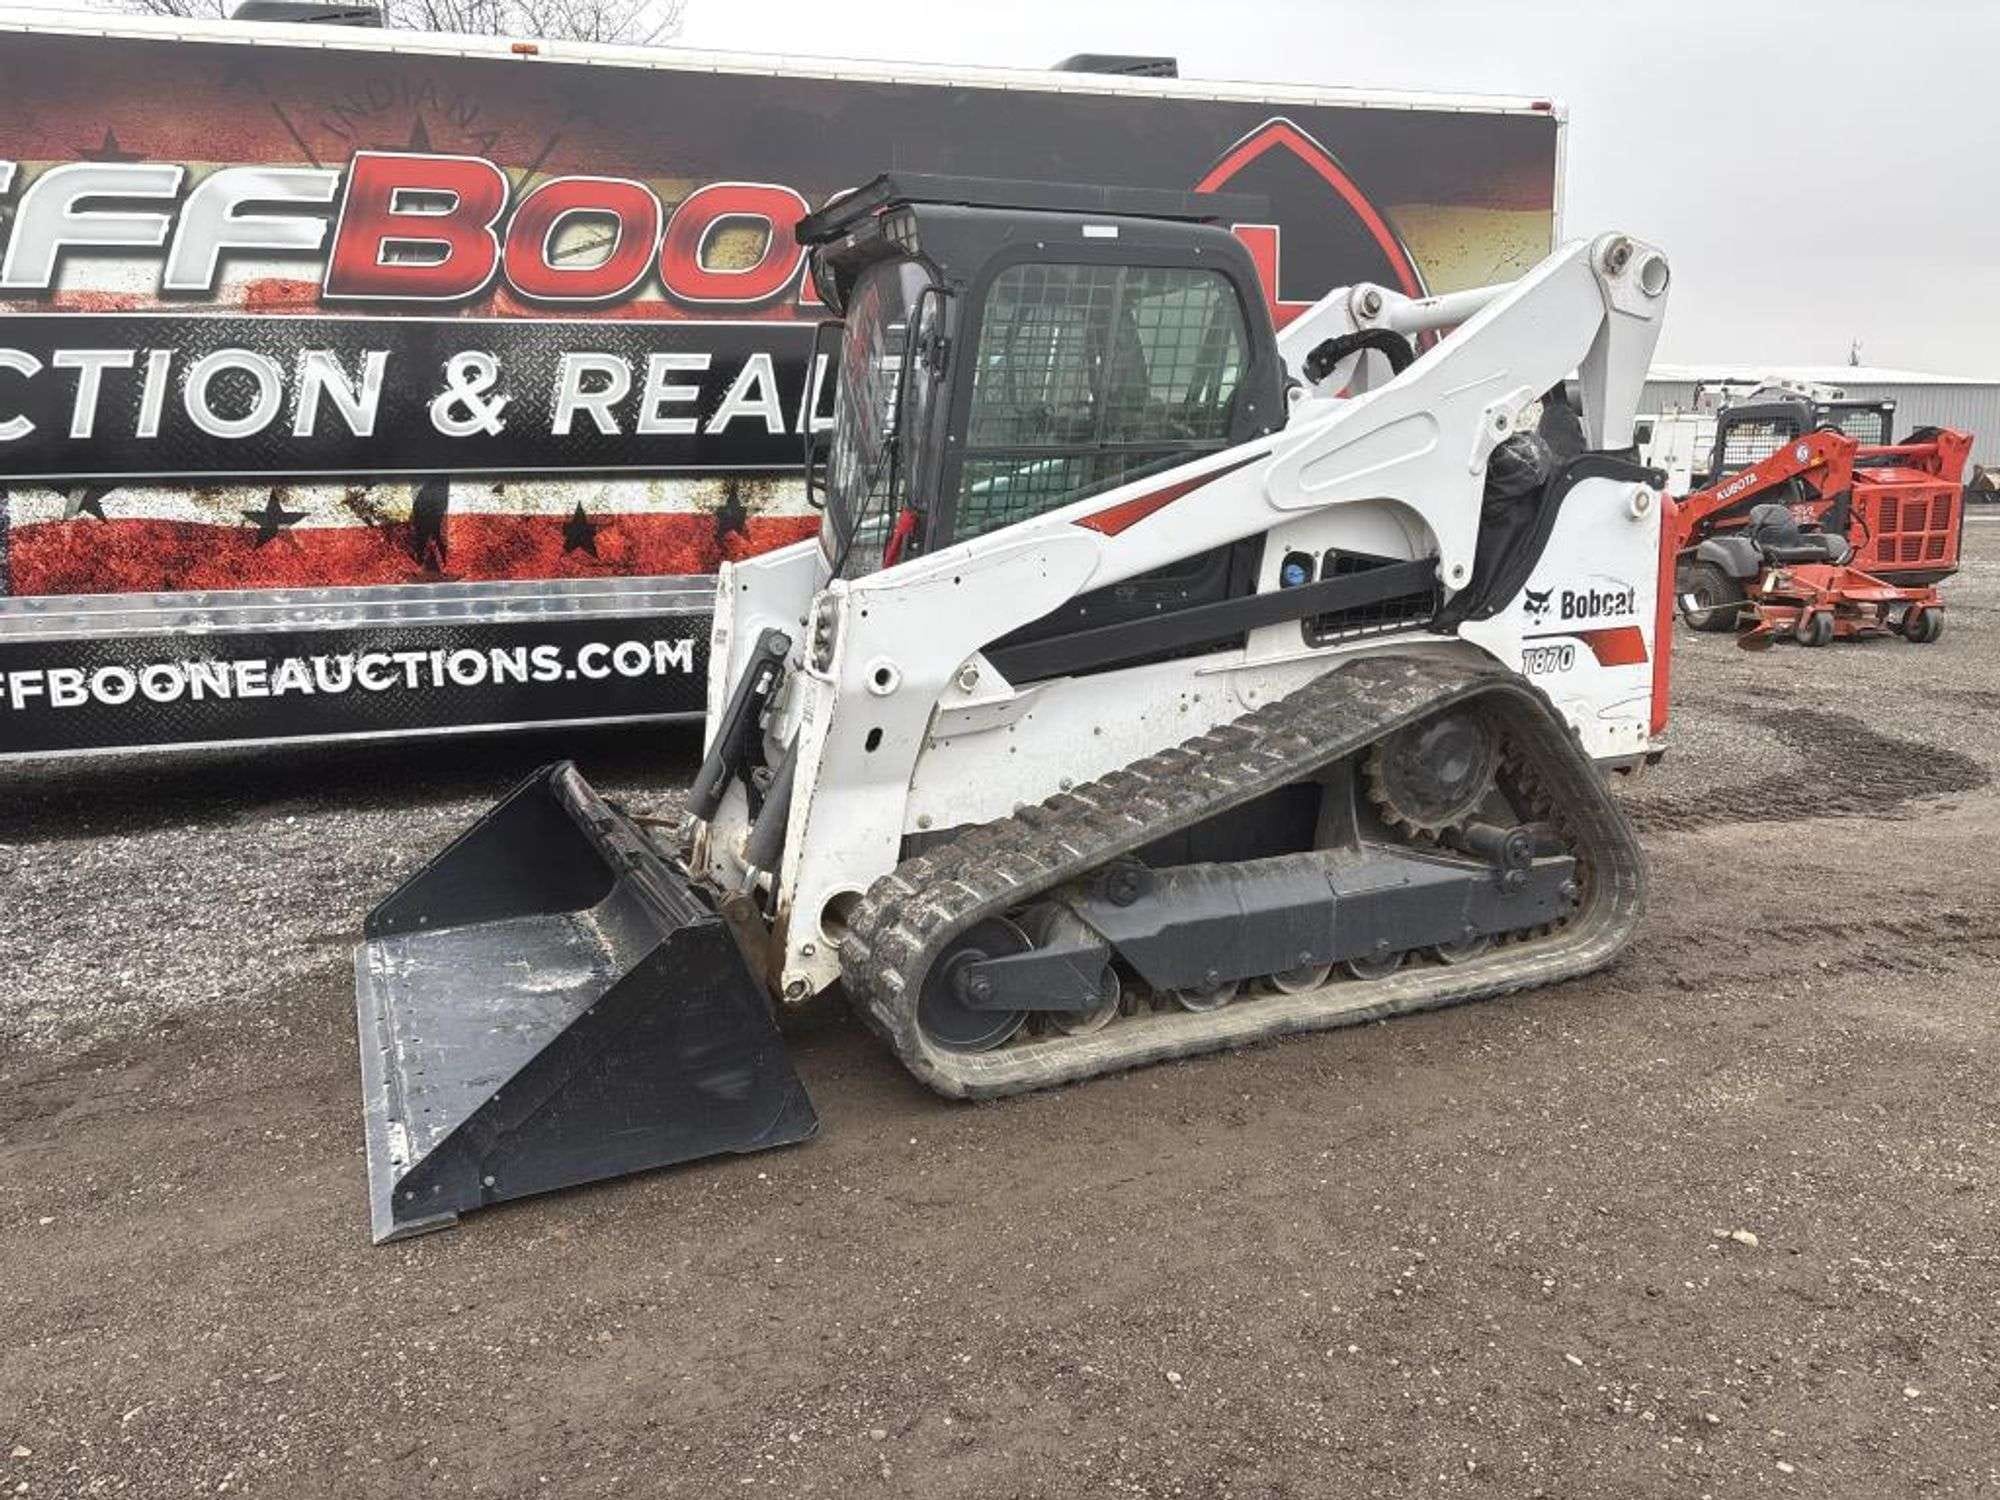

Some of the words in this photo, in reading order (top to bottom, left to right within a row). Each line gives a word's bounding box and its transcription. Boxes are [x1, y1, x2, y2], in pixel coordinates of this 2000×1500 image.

[427, 352, 507, 437] &
[1716, 473, 1758, 501] KUBOTA
[1561, 586, 1635, 620] Bobcat
[0, 638, 695, 710] FBOONEAUCTIONS.COM
[1522, 645, 1575, 675] T870
